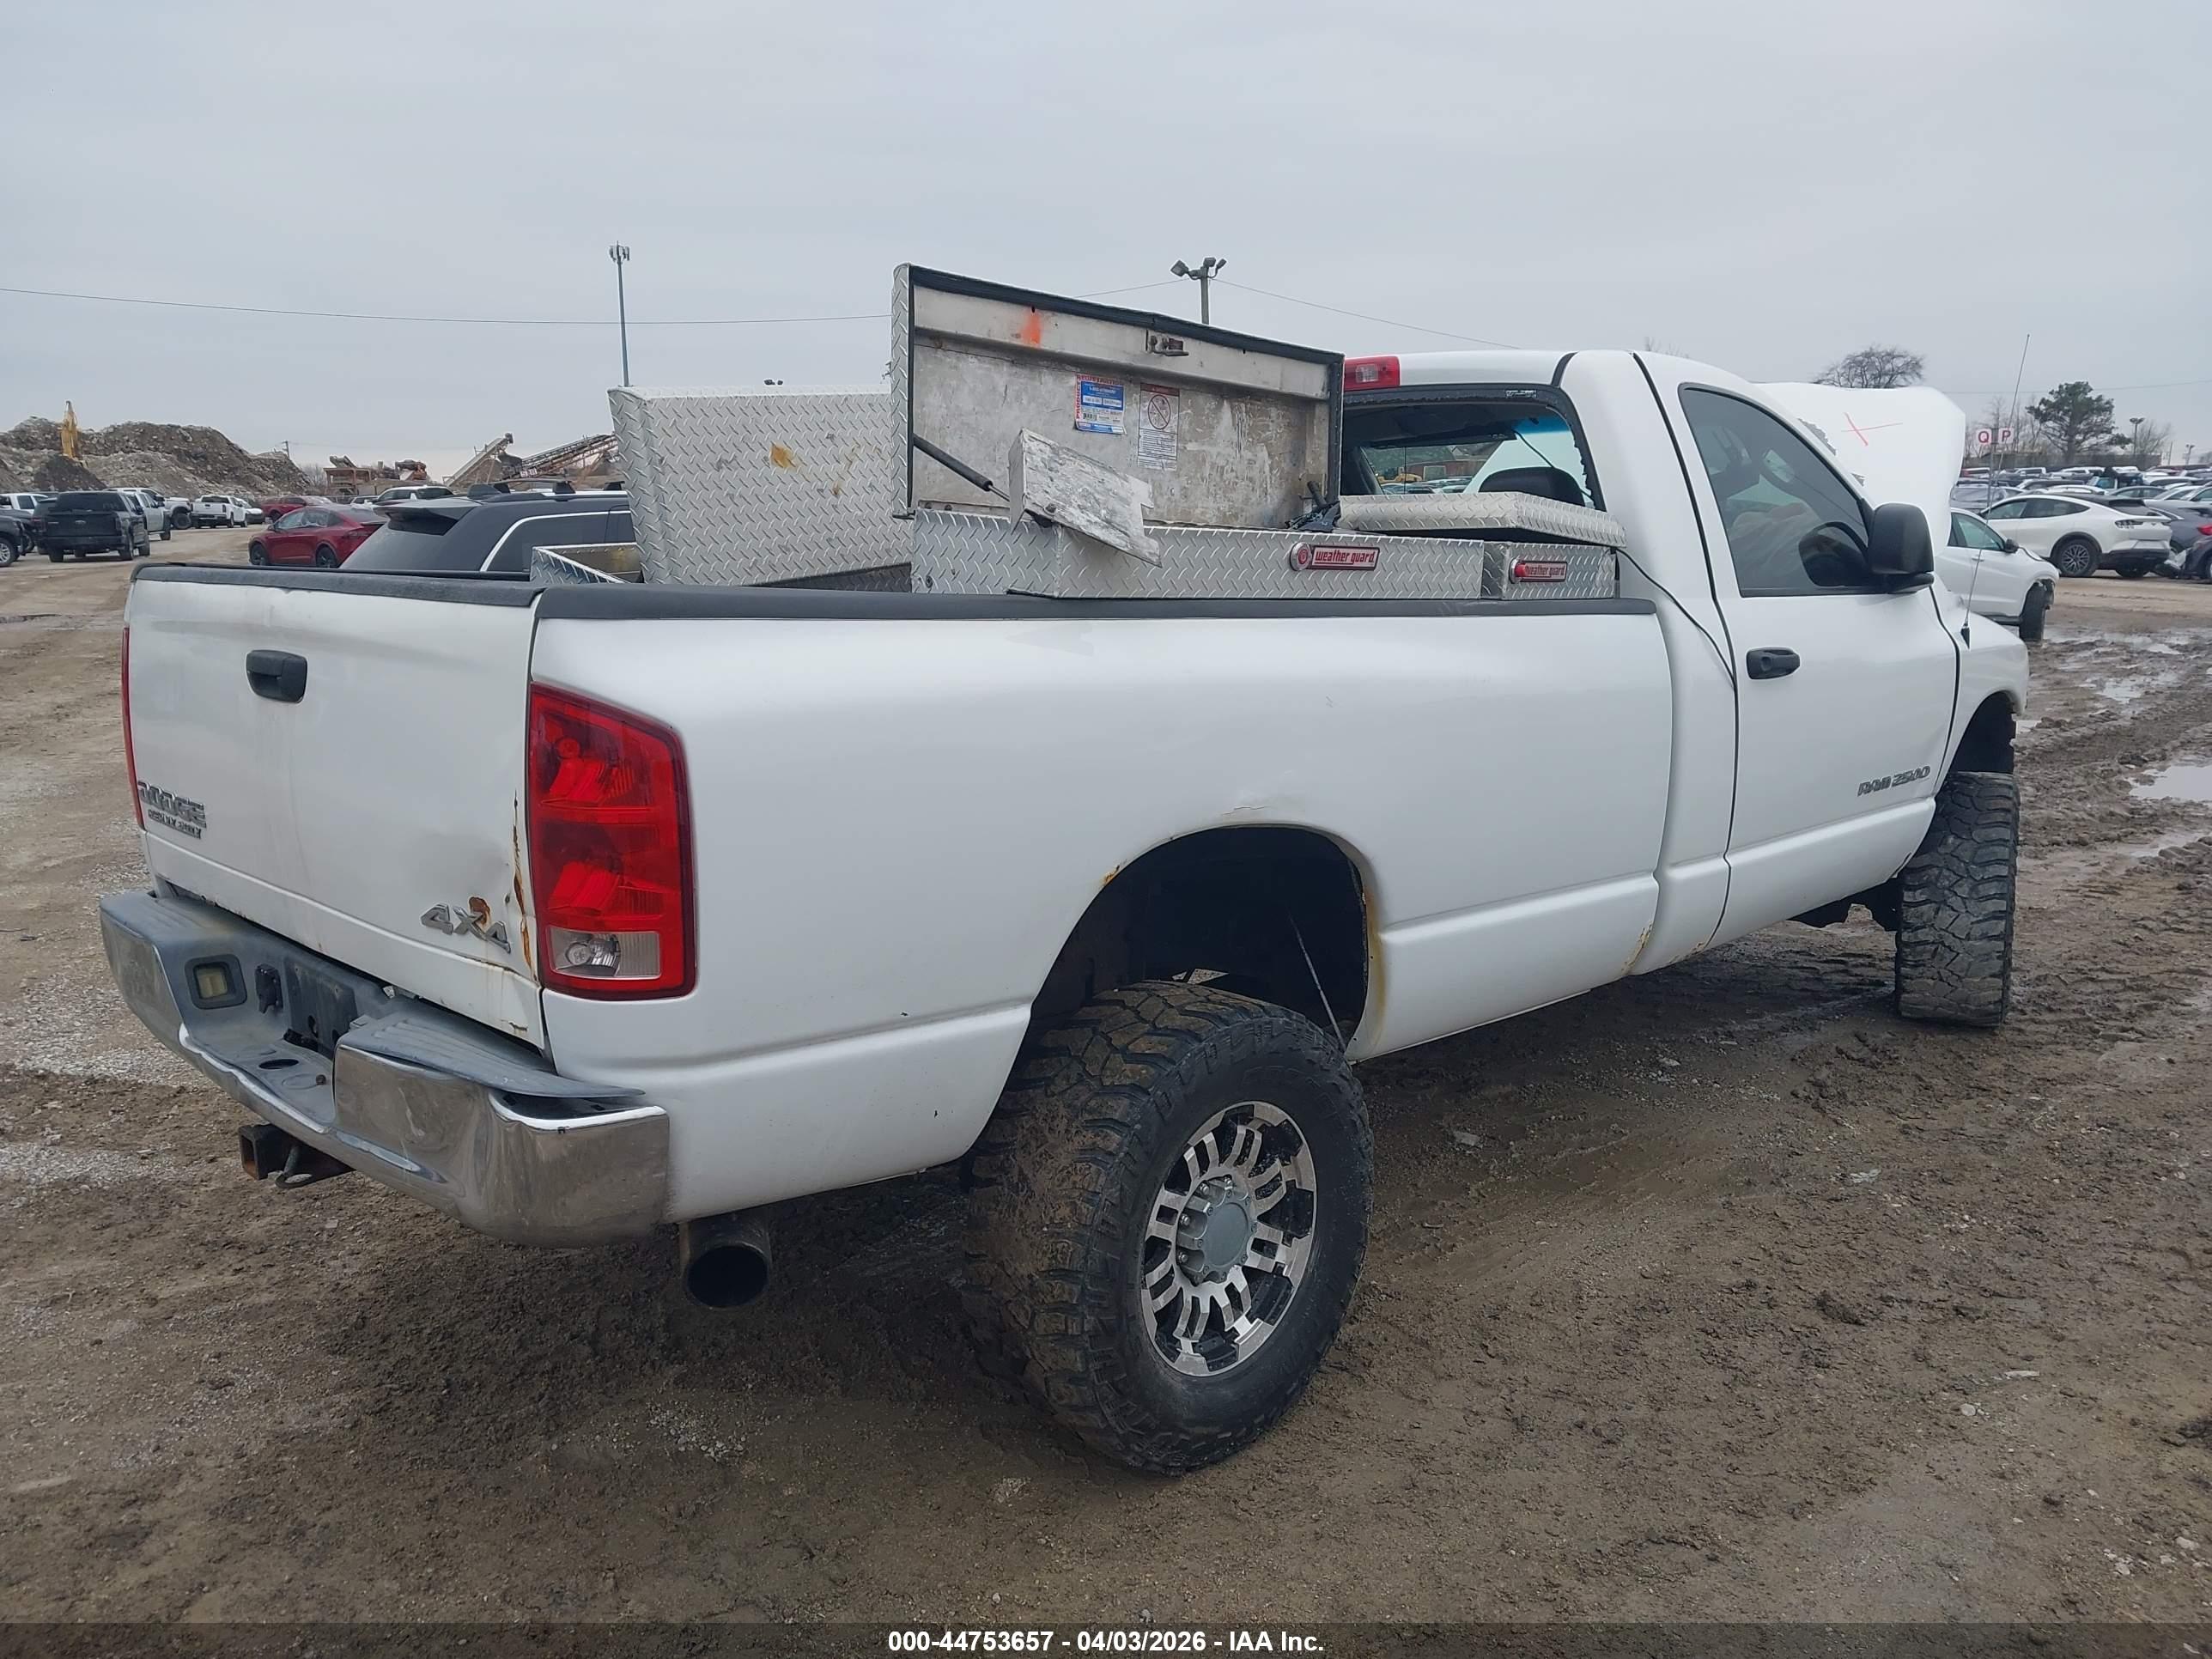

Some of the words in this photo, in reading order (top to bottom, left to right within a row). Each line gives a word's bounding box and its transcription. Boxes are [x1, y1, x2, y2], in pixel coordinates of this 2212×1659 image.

[1978, 430, 1990, 443] Q
[2002, 430, 2011, 442] P
[1315, 549, 1351, 562] weather
[1350, 550, 1376, 563] guard
[1857, 775, 1892, 797] RAM
[1892, 765, 1931, 787] 2500
[137, 780, 207, 830] DODGE
